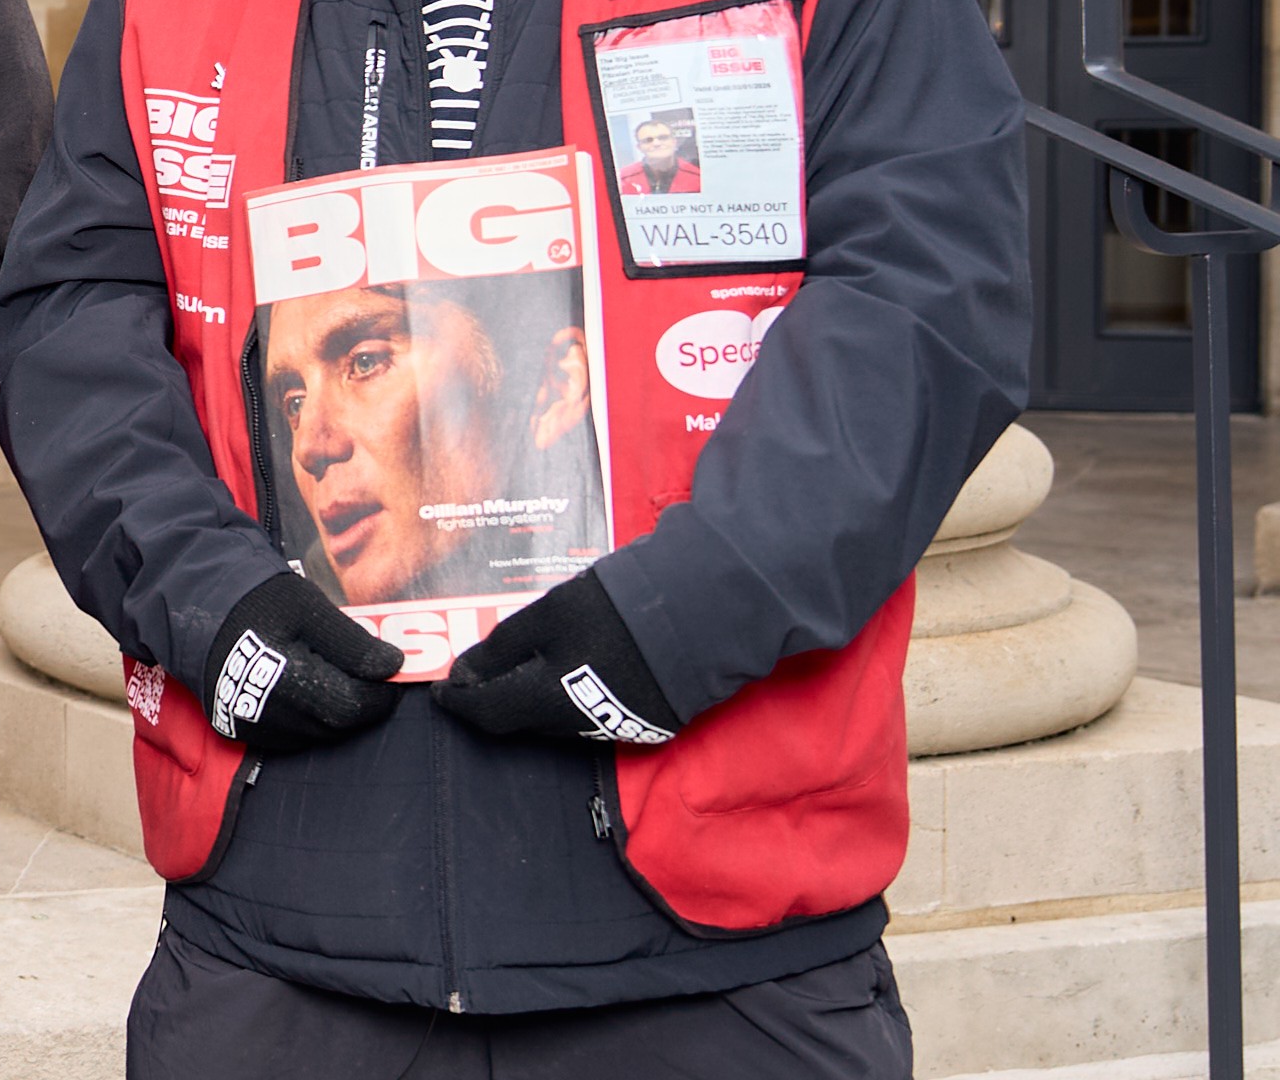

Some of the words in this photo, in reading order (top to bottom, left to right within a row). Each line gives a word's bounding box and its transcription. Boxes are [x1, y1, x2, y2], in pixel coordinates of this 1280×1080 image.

[710, 48, 739, 59] BIG
[712, 62, 763, 74] ISSUE
[146, 98, 219, 142] BIG
[635, 205, 669, 215] HAND
[672, 204, 687, 214] UP
[690, 204, 713, 213] NOT
[716, 204, 724, 212] A
[727, 203, 761, 213] HAND
[763, 202, 788, 212] OUT
[248, 172, 577, 305] BIG
[641, 222, 789, 247] WAL-3540
[550, 244, 571, 259] £4
[419, 503, 482, 520] Cillian
[483, 496, 569, 514] Murphy
[436, 518, 475, 532] fights
[475, 516, 499, 527] the
[500, 512, 554, 527] system
[489, 560, 512, 568] How
[216, 638, 257, 734] ISSUE
[233, 655, 279, 719] BIG
